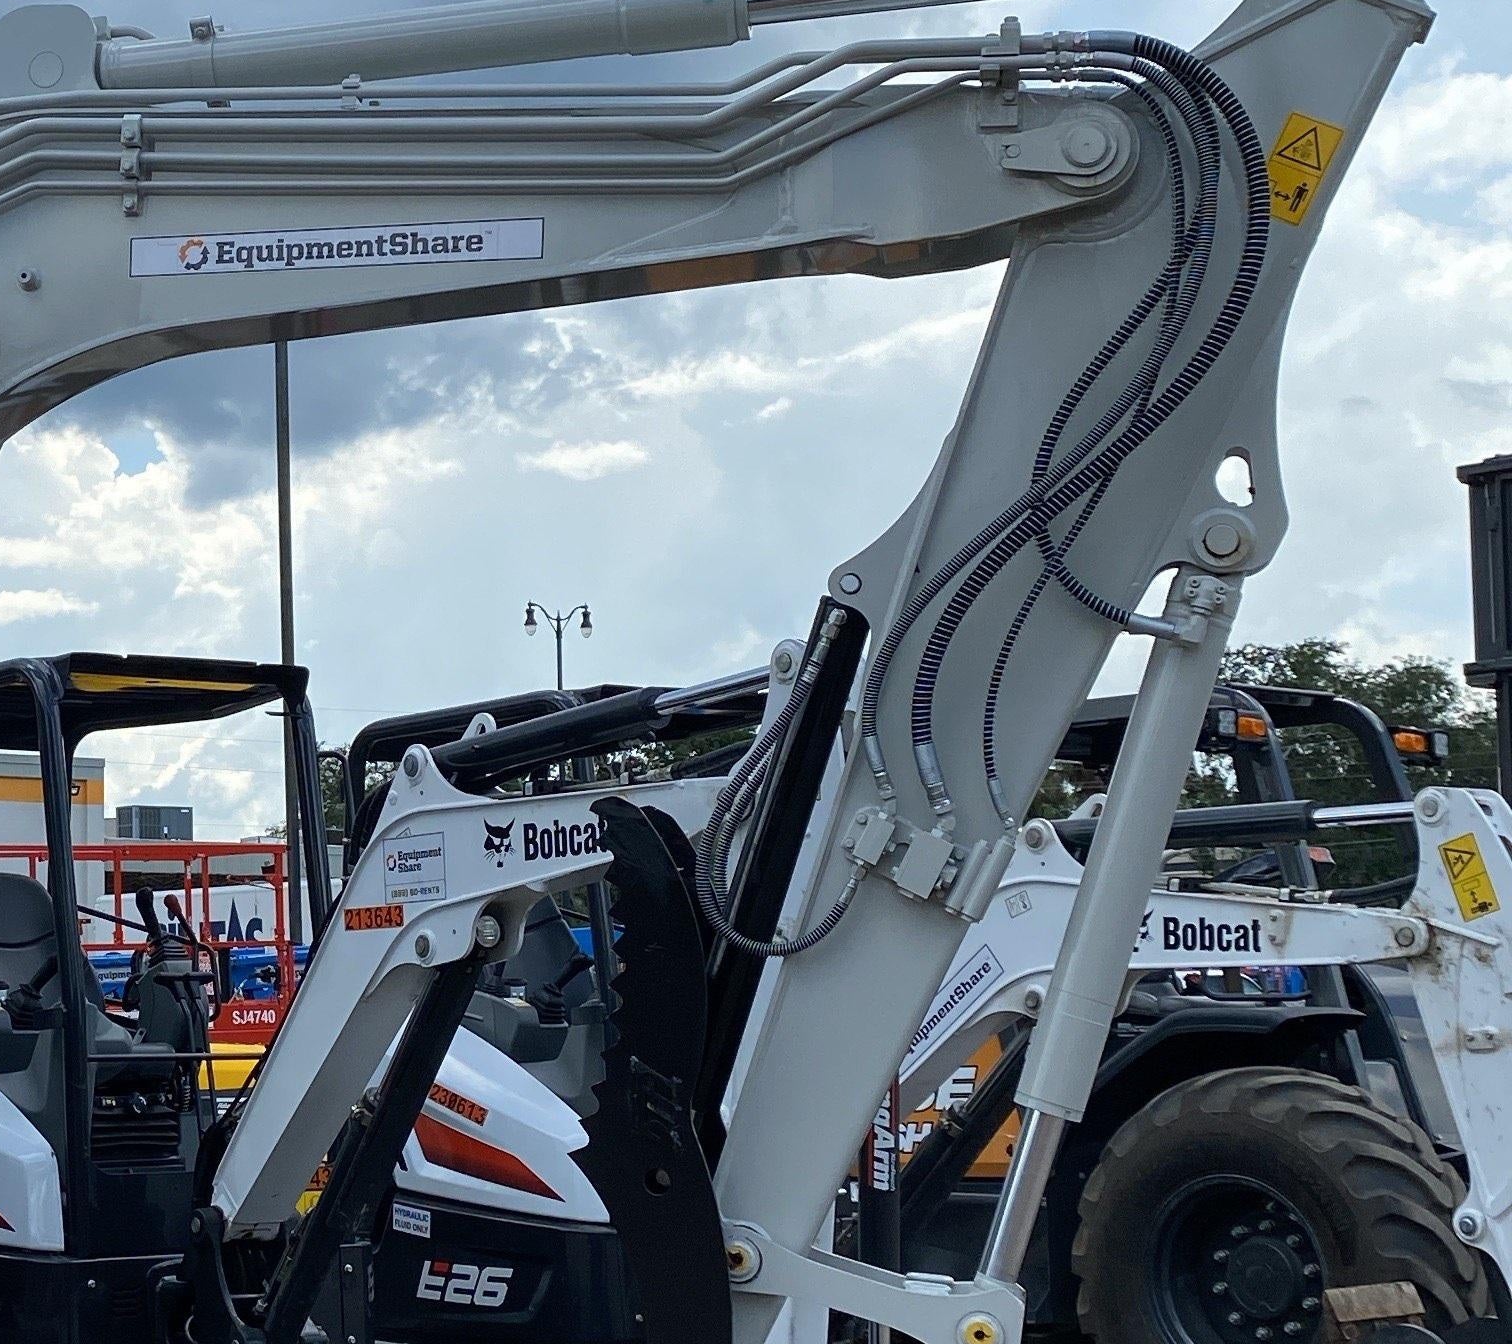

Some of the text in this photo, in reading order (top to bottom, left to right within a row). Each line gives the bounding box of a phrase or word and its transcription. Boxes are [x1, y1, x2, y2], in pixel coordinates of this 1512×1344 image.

[215, 232, 484, 269] EquipmentShare
[397, 847, 442, 862] Equipment
[397, 862, 422, 873] Share
[345, 905, 404, 930] 213643
[1163, 916, 1261, 952] Bobcat
[232, 1009, 276, 1025] SJ4740
[394, 1207, 429, 1223] HYDRAULIC
[394, 1218, 429, 1234] FLUID ONLY
[416, 1260, 514, 1307] E26
